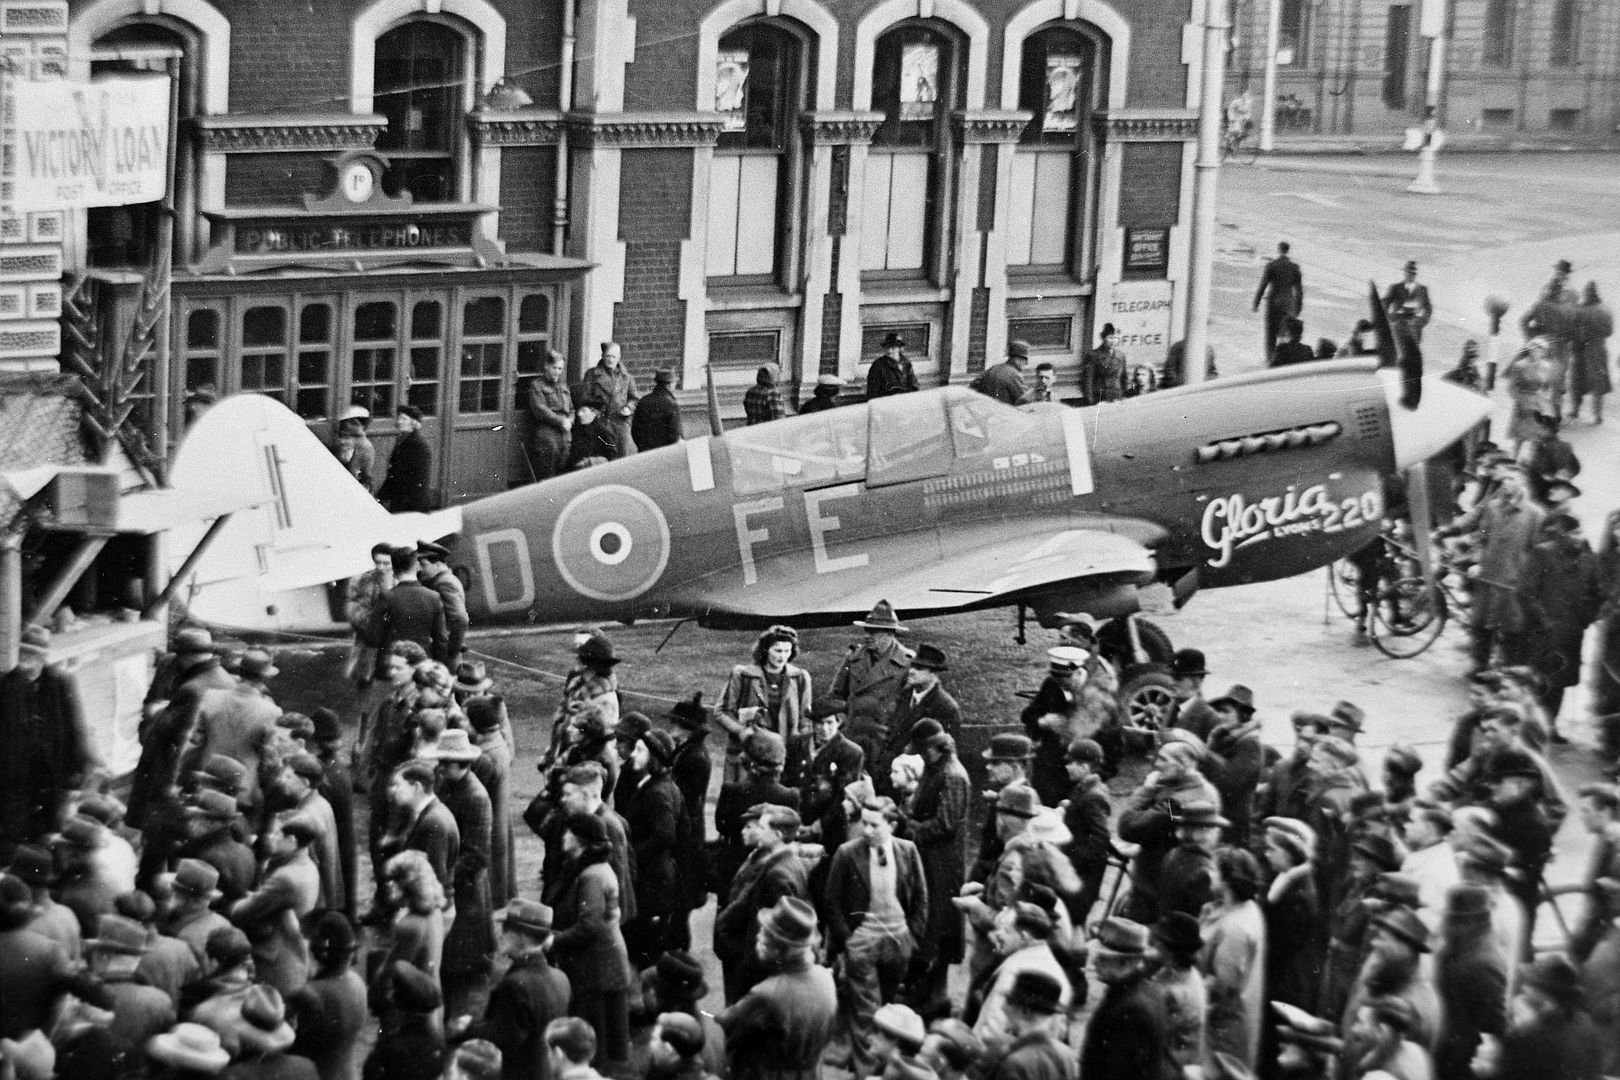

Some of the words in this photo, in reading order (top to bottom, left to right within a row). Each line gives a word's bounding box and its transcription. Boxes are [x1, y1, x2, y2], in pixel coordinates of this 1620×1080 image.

[24, 128, 103, 178] VICTORY
[113, 124, 164, 173] LOAN
[333, 225, 459, 249] TELEPHONES
[1112, 300, 1172, 313] TELEGRAPH
[1201, 484, 1329, 568] Gloria
[1320, 490, 1384, 533] 220
[475, 528, 535, 614] D
